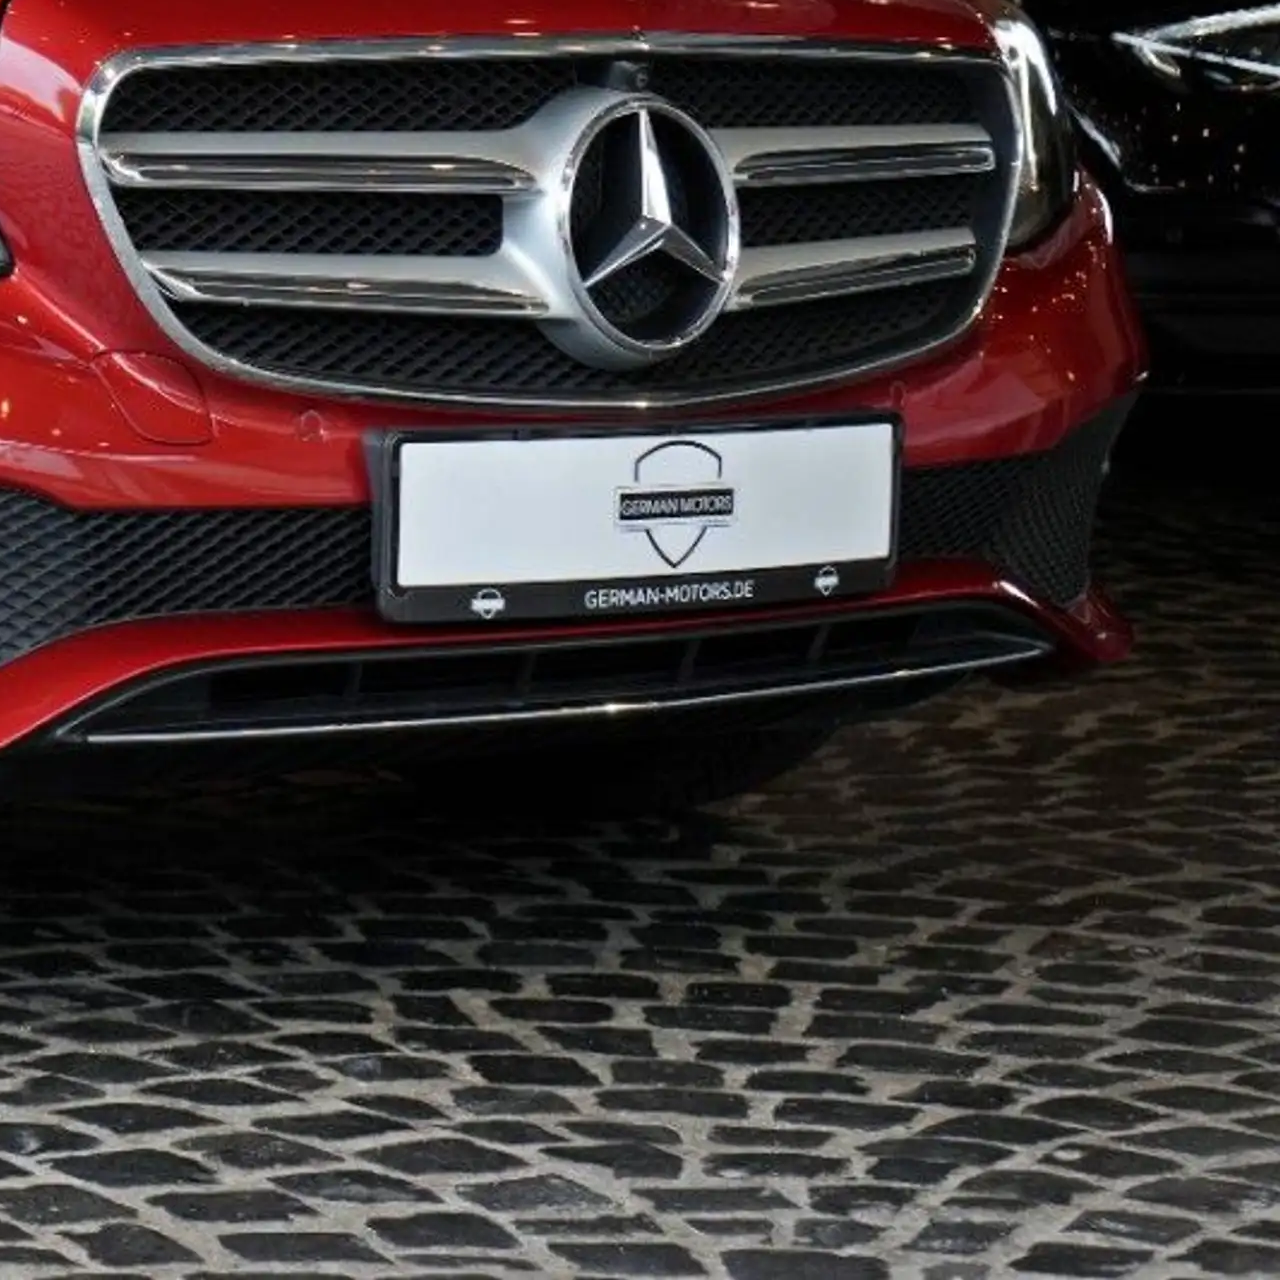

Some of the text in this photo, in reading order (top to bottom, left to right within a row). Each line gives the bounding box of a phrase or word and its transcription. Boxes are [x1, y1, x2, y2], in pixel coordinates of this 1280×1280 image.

[622, 495, 732, 516] GERMAN MOTORS
[584, 579, 755, 610] GERMAN-MOTORS.DE
